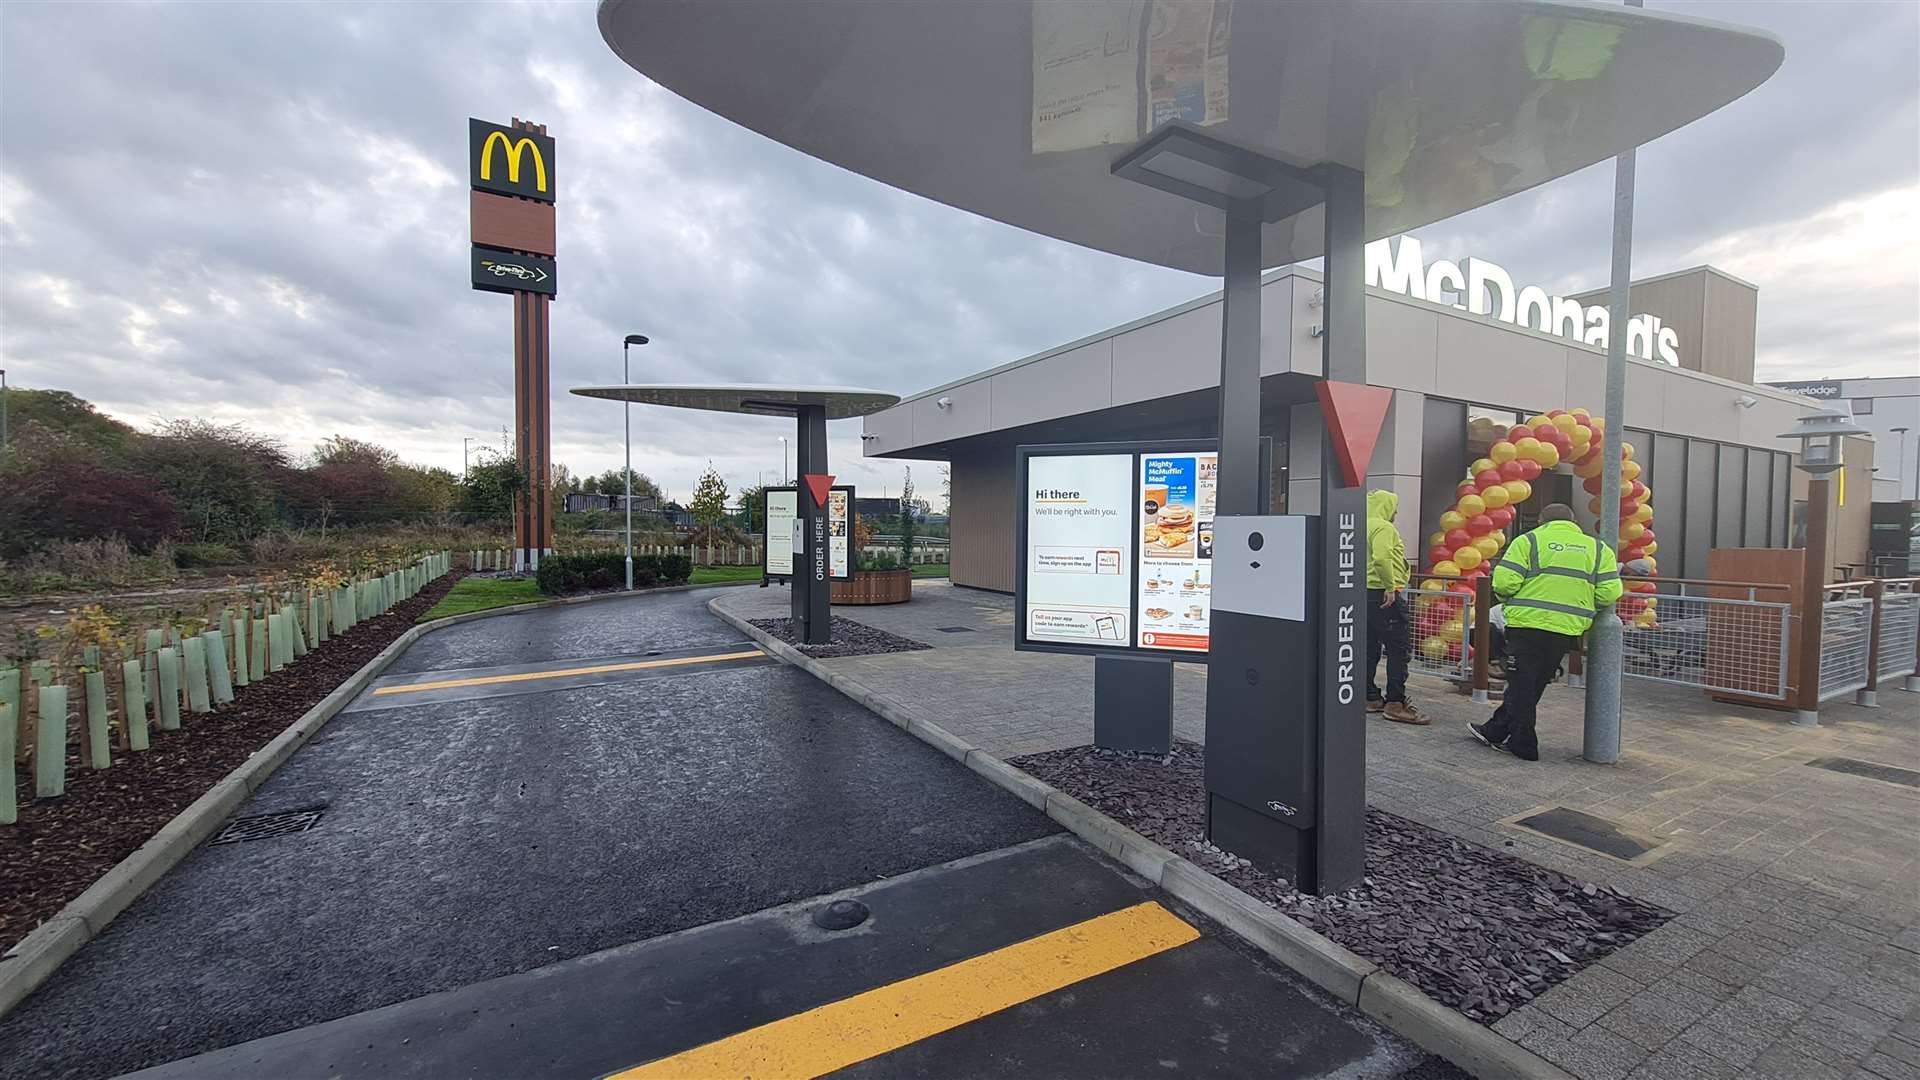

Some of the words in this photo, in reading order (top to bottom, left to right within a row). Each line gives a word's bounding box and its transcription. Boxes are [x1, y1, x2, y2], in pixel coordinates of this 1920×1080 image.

[1364, 235, 1680, 368] McDonad's
[1782, 385, 1838, 396] avelodge
[1148, 460, 1173, 468] Mighty
[1035, 489, 1048, 499] Hi
[1050, 489, 1080, 499] there
[1035, 508, 1052, 516] We'll
[1053, 508, 1063, 516] be
[1064, 508, 1082, 517] right
[1083, 508, 1101, 516] with
[816, 516, 824, 543] HERE
[816, 547, 824, 581] ORDER
[1338, 513, 1355, 588] HERE
[1338, 604, 1354, 705] ORDER
